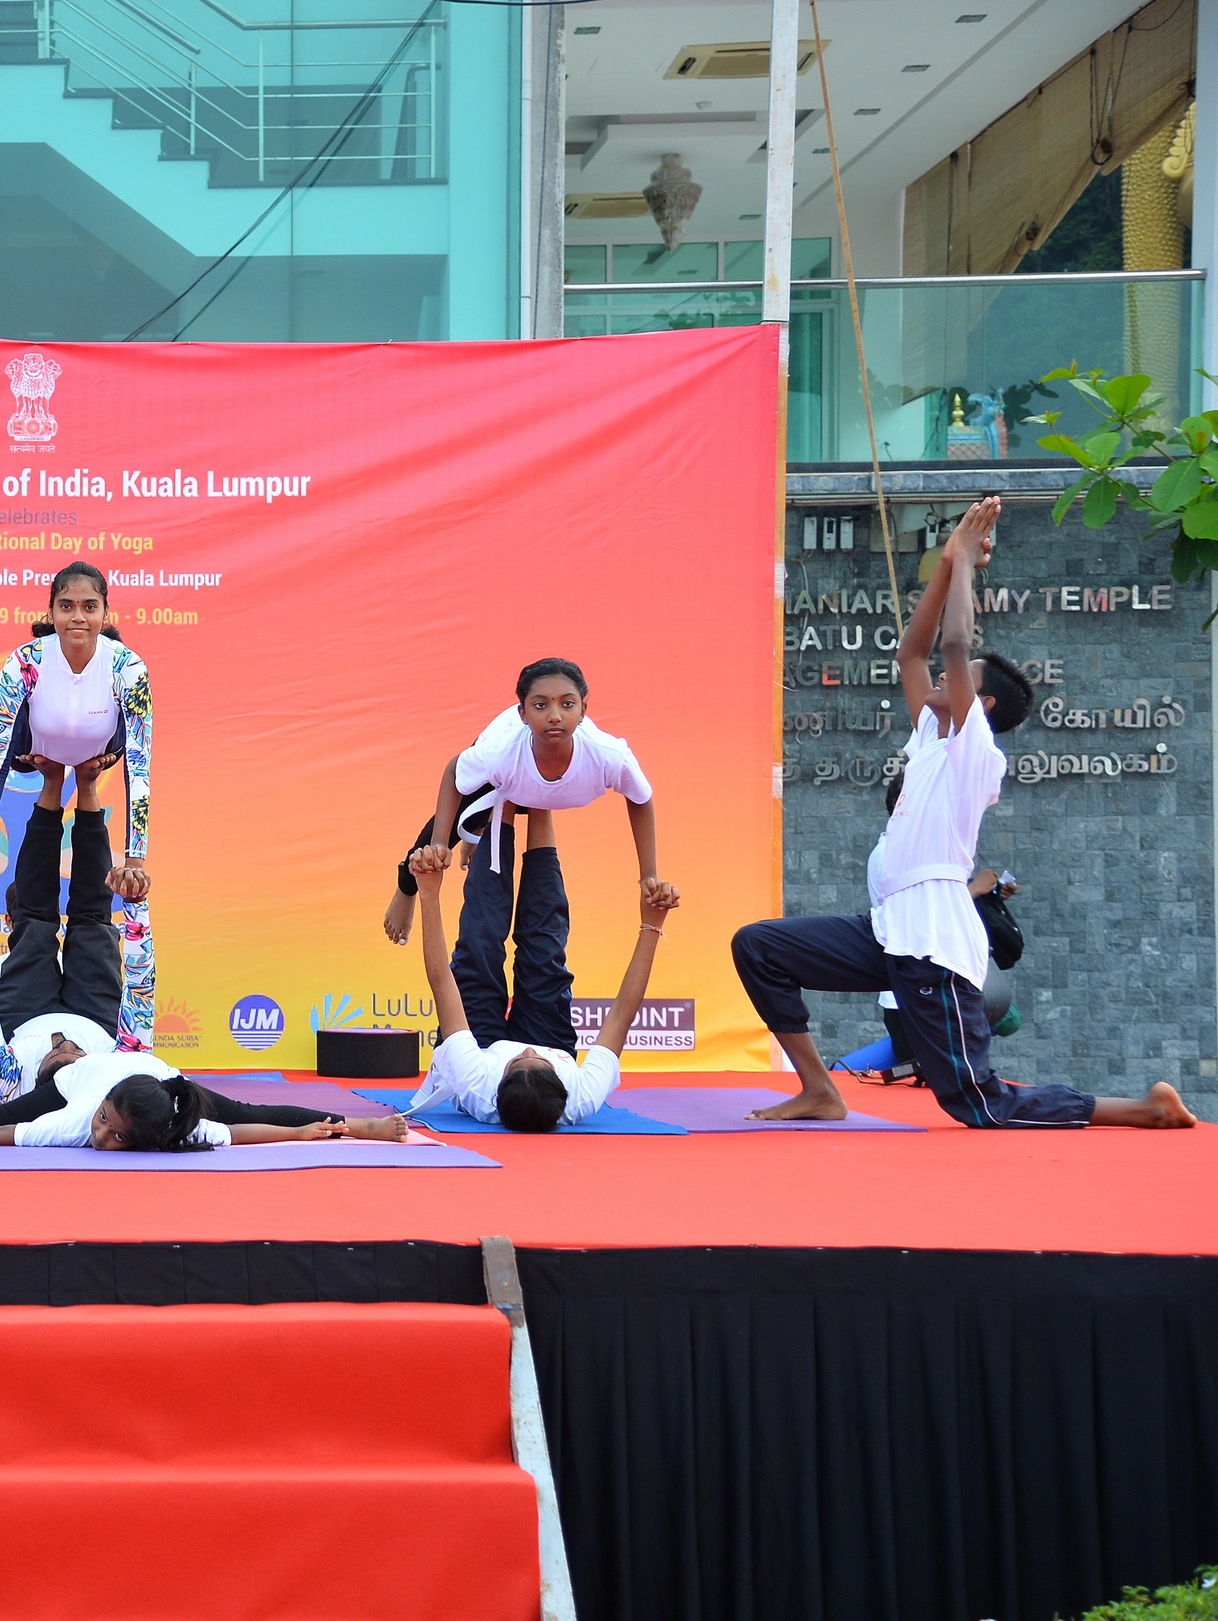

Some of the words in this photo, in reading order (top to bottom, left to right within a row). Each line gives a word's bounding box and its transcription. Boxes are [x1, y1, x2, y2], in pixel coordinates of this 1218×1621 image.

[2, 468, 32, 497] of
[39, 468, 113, 502] India,
[122, 469, 199, 498] Kuala
[207, 470, 312, 504] Lumpur
[50, 532, 83, 555] Day
[87, 531, 106, 550] of
[110, 533, 153, 555] Yoga
[108, 569, 155, 587] Kuala
[159, 570, 222, 591] Lumpur
[785, 588, 899, 615] ANIAR
[1038, 584, 1172, 613] TEMPLE
[136, 608, 198, 624] 9.00am
[783, 624, 863, 651] BATU
[1040, 695, 1186, 730] கோயில்
[372, 992, 433, 1017] LuLu
[232, 1008, 280, 1030] IJM
[177, 1034, 199, 1042] SURIA
